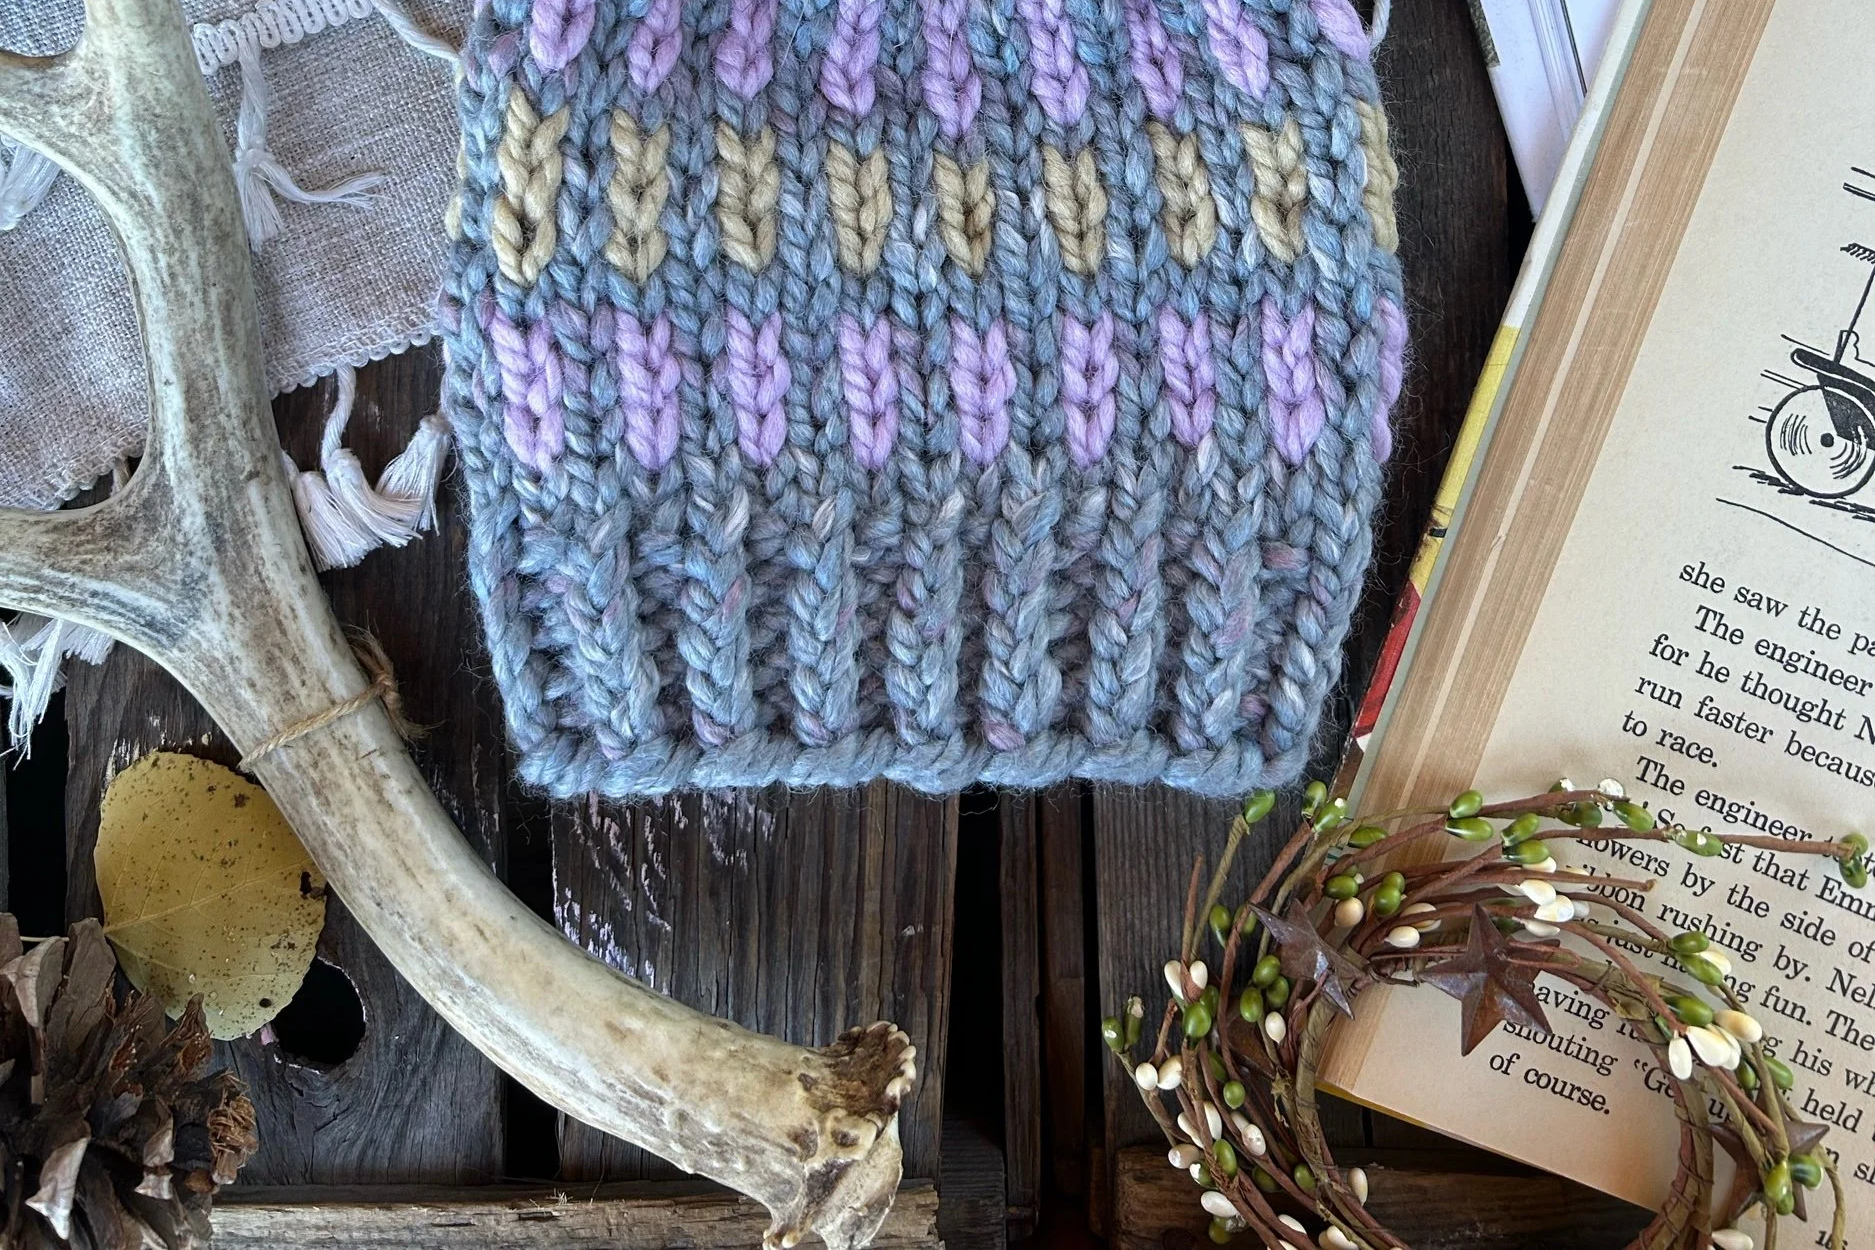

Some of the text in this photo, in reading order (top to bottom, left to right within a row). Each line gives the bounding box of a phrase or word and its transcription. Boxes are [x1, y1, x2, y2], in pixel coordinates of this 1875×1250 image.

[1679, 561, 1725, 594] she
[1733, 586, 1789, 618] saw
[1797, 605, 1842, 641] the
[1649, 633, 1690, 666] for
[1695, 650, 1731, 684] he
[1740, 670, 1847, 731] thought
[1695, 605, 1874, 697] The engineer
[1622, 710, 1718, 768] to race.
[1635, 676, 1875, 788] run faster becaus
[1636, 756, 1686, 797] The
[1694, 788, 1813, 843] engineer
[1680, 862, 1716, 897] by
[1726, 883, 1771, 918] the
[1780, 910, 1837, 947] side
[1848, 940, 1875, 964] of
[1752, 850, 1811, 892] that
[1656, 903, 1764, 963] rushing
[1772, 944, 1812, 982] by.
[1825, 967, 1875, 1010] Nel
[1532, 983, 1864, 1133] aving held
[1759, 985, 1812, 1026] fun.
[1825, 1009, 1875, 1051] The
[1789, 1039, 1833, 1077] his
[1490, 1052, 1610, 1115] of course.
